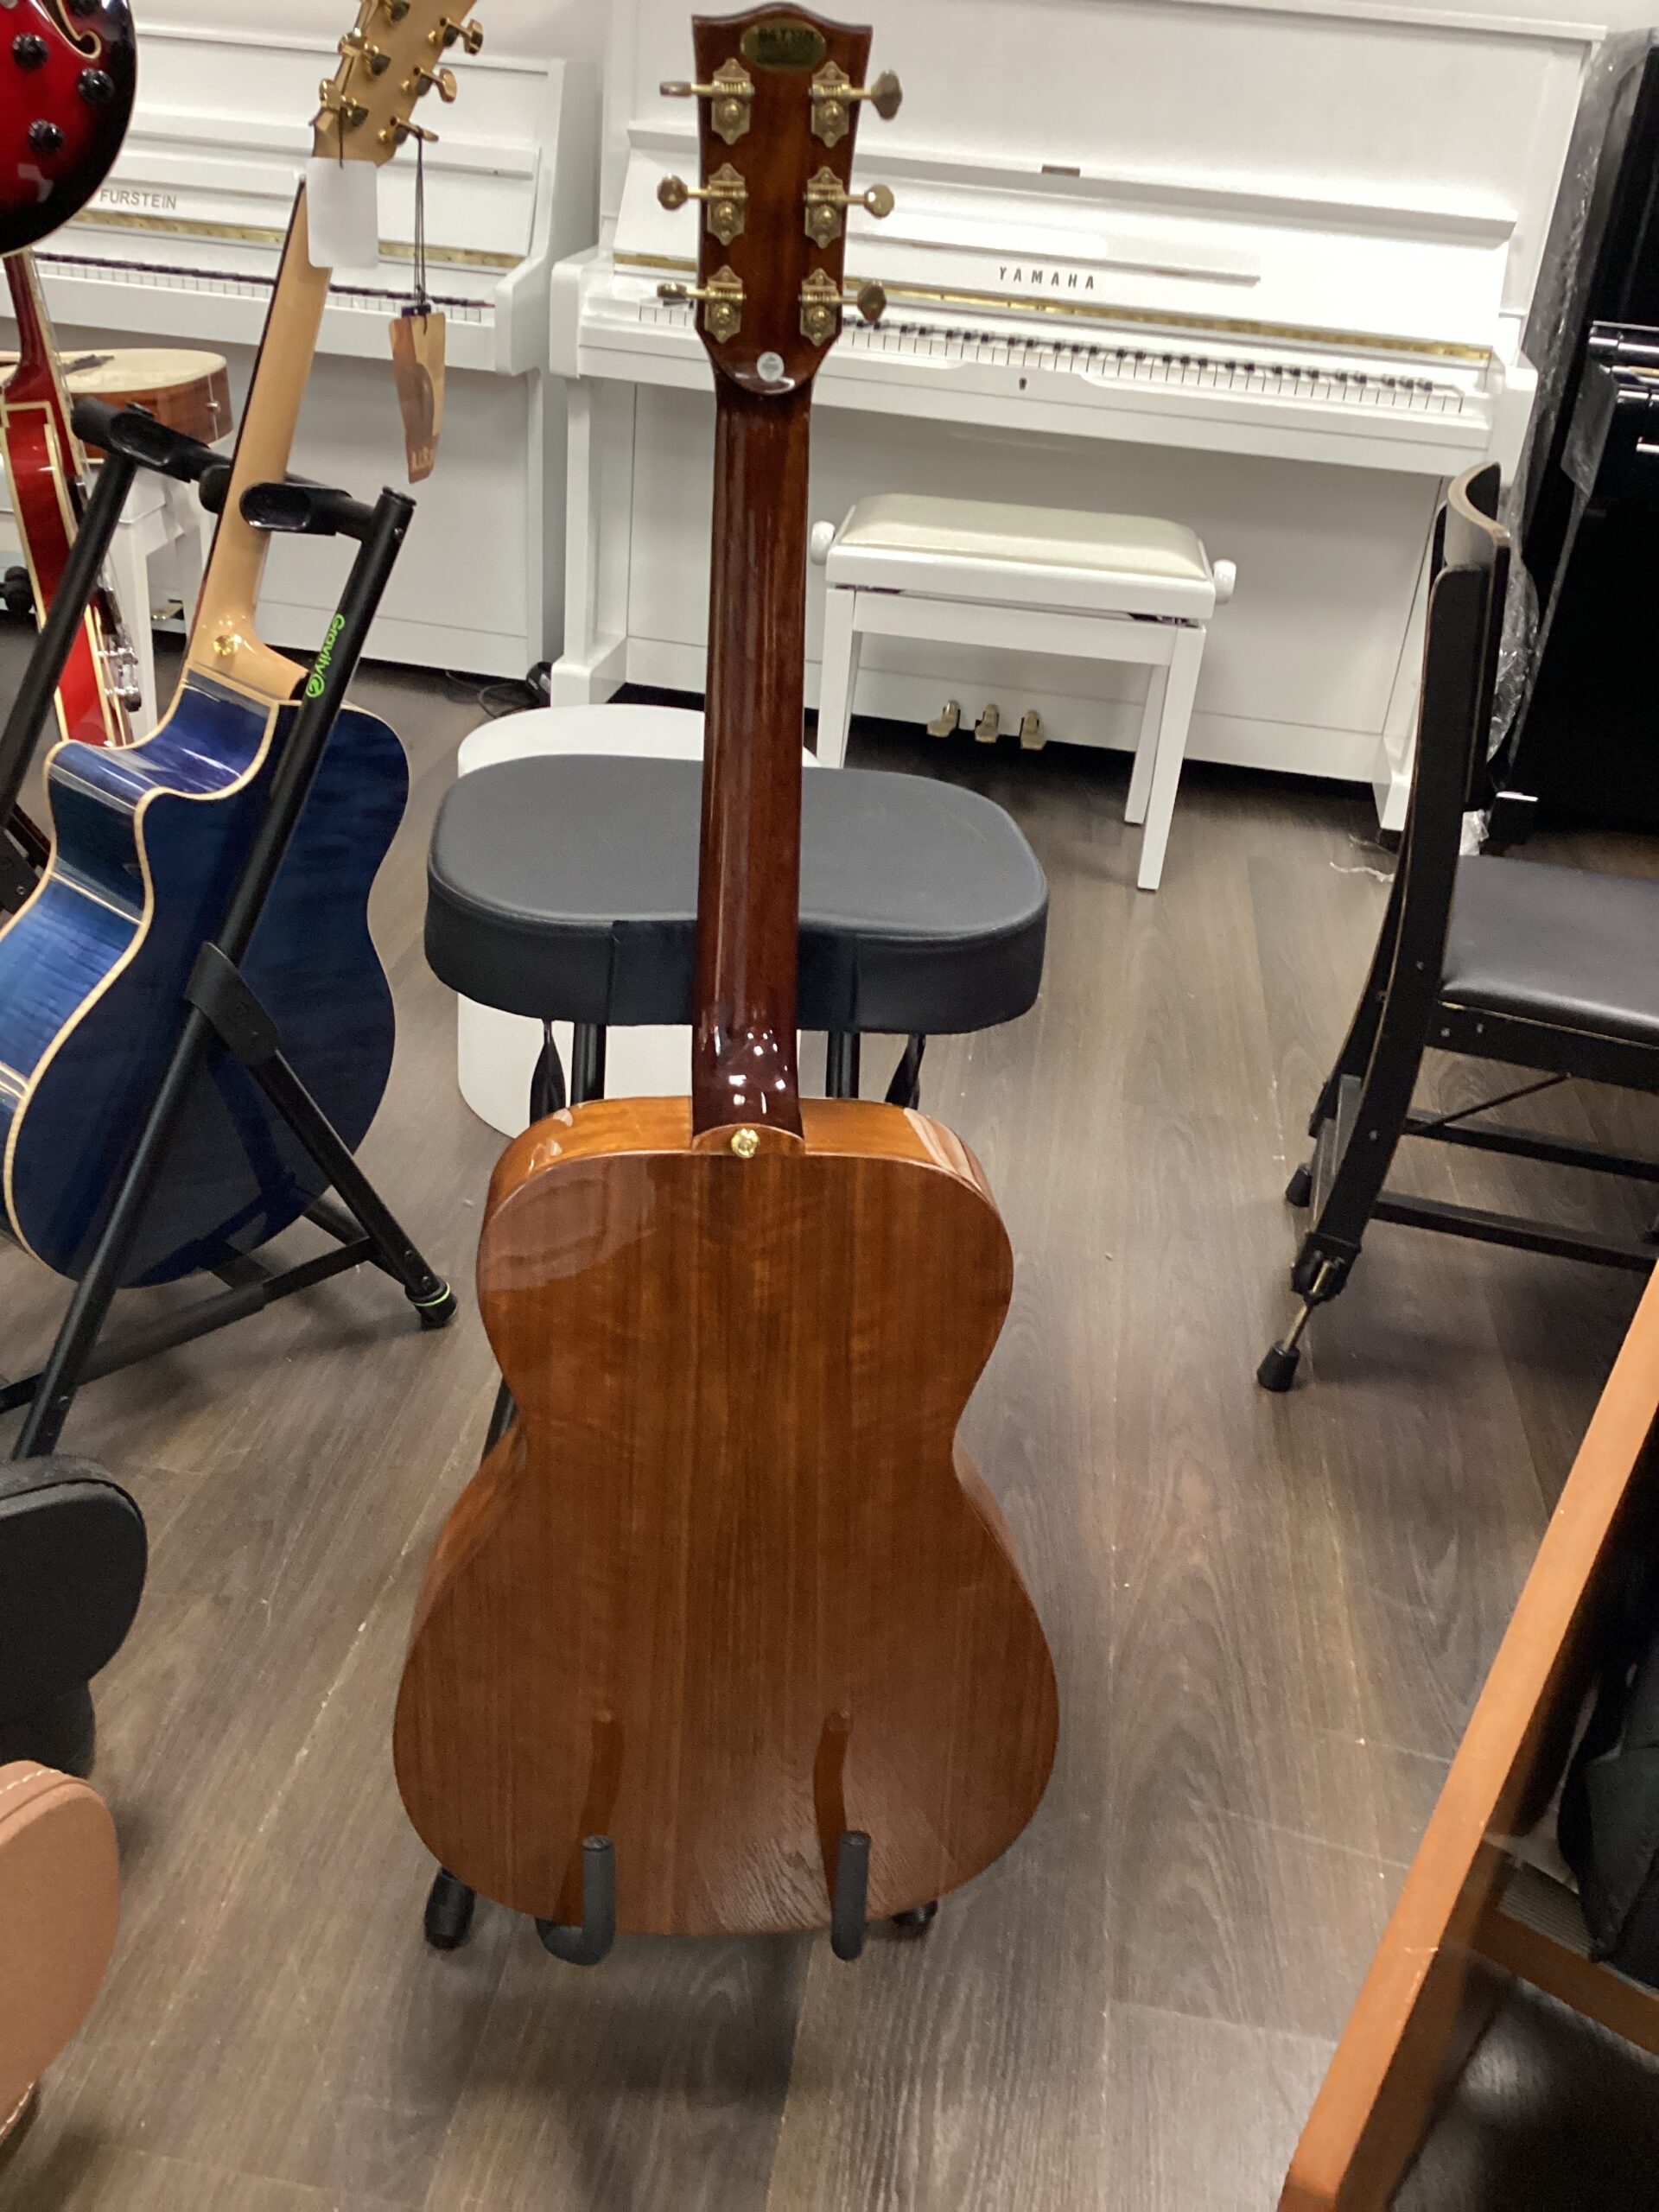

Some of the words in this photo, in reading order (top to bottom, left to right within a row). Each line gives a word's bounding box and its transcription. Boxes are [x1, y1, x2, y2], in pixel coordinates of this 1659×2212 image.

[99, 188, 177, 210] FURSTEIN
[999, 266, 1095, 289] YAMAHA
[315, 613, 346, 676] Gravity
